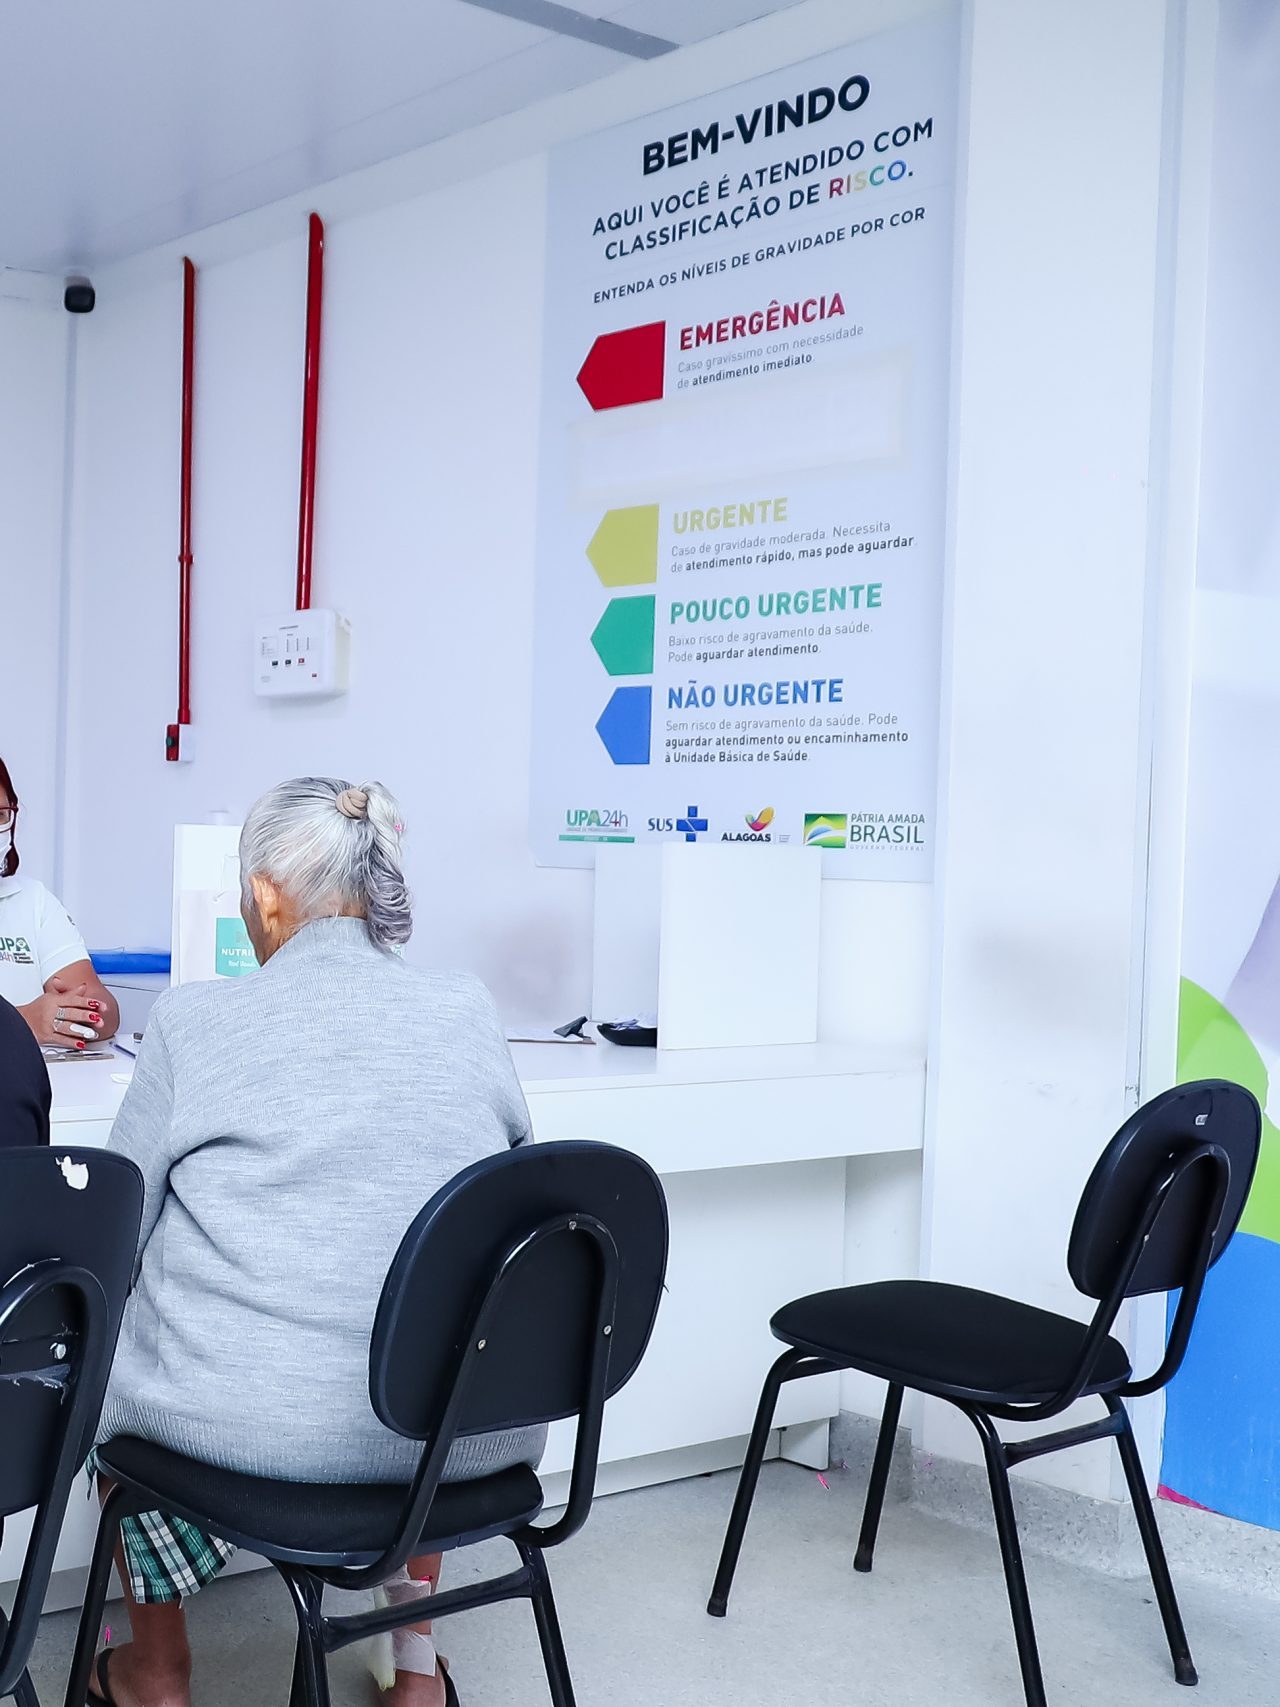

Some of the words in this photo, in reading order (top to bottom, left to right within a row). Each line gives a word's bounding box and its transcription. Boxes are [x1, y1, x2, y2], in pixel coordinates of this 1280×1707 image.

[643, 74, 870, 175] BEM-VINDO
[593, 205, 643, 236] AQUI
[651, 181, 709, 219] VOCÊ
[718, 174, 729, 199] É
[738, 141, 864, 192] ATENDIDO
[874, 118, 933, 152] COM
[605, 197, 780, 260] CLASSIFICAÇÃO
[789, 184, 819, 210] DE
[829, 160, 913, 198] RISCO.
[594, 279, 654, 303] ENTENDA
[659, 272, 677, 286] OS
[682, 260, 727, 280] NÍVEIS
[731, 253, 750, 269] DE
[755, 227, 846, 261] GRAVIDADE
[851, 218, 884, 237] POR
[890, 207, 925, 226] COR
[680, 293, 845, 350] EMERGÊNCIA
[678, 360, 703, 373] Caso
[706, 348, 763, 370] gravíssimo
[766, 342, 789, 354] com
[792, 325, 863, 348] necessidade
[677, 379, 689, 389] de
[693, 365, 759, 386] atendimento
[673, 498, 788, 534] URGENTE
[671, 545, 696, 557] Caso
[699, 543, 711, 553] de
[715, 536, 765, 556] gravidade
[833, 521, 890, 537] Necessita
[671, 563, 683, 572] de
[686, 554, 752, 571] atendimento
[756, 549, 794, 564] rápido,
[798, 548, 821, 559] mas
[826, 544, 854, 558] pode
[671, 596, 749, 624] POUCO
[759, 583, 881, 616] URGENTE
[669, 636, 696, 646] Baixo
[699, 634, 724, 644] risco
[727, 632, 739, 642] de
[742, 626, 814, 644] agravamento
[818, 625, 832, 636] da
[835, 622, 872, 634] saúde.
[669, 652, 693, 662] Pode
[696, 648, 744, 662] aguardar
[668, 680, 716, 709] NÃO
[725, 678, 843, 707] URGENTE
[666, 721, 688, 731] Sem
[691, 720, 716, 730] risco
[720, 720, 731, 729] de
[735, 717, 805, 732] agravamento
[809, 716, 822, 727] da
[826, 714, 864, 726] saúde.
[869, 713, 897, 725] Pode
[665, 737, 711, 749] aguardar
[716, 734, 784, 746] atendimento
[788, 735, 801, 744] ou
[804, 731, 908, 744] encaminhamento
[665, 751, 670, 763] à
[674, 752, 715, 763] Unidade
[719, 751, 753, 762] Básica
[757, 751, 770, 761] de
[648, 818, 673, 831] SUS
[851, 811, 884, 823] PÁTRIA
[888, 814, 925, 824] AMADA
[721, 832, 771, 842] ALAGOAS
[850, 825, 924, 843] BRASIL
[222, 948, 254, 956] NUTRI
